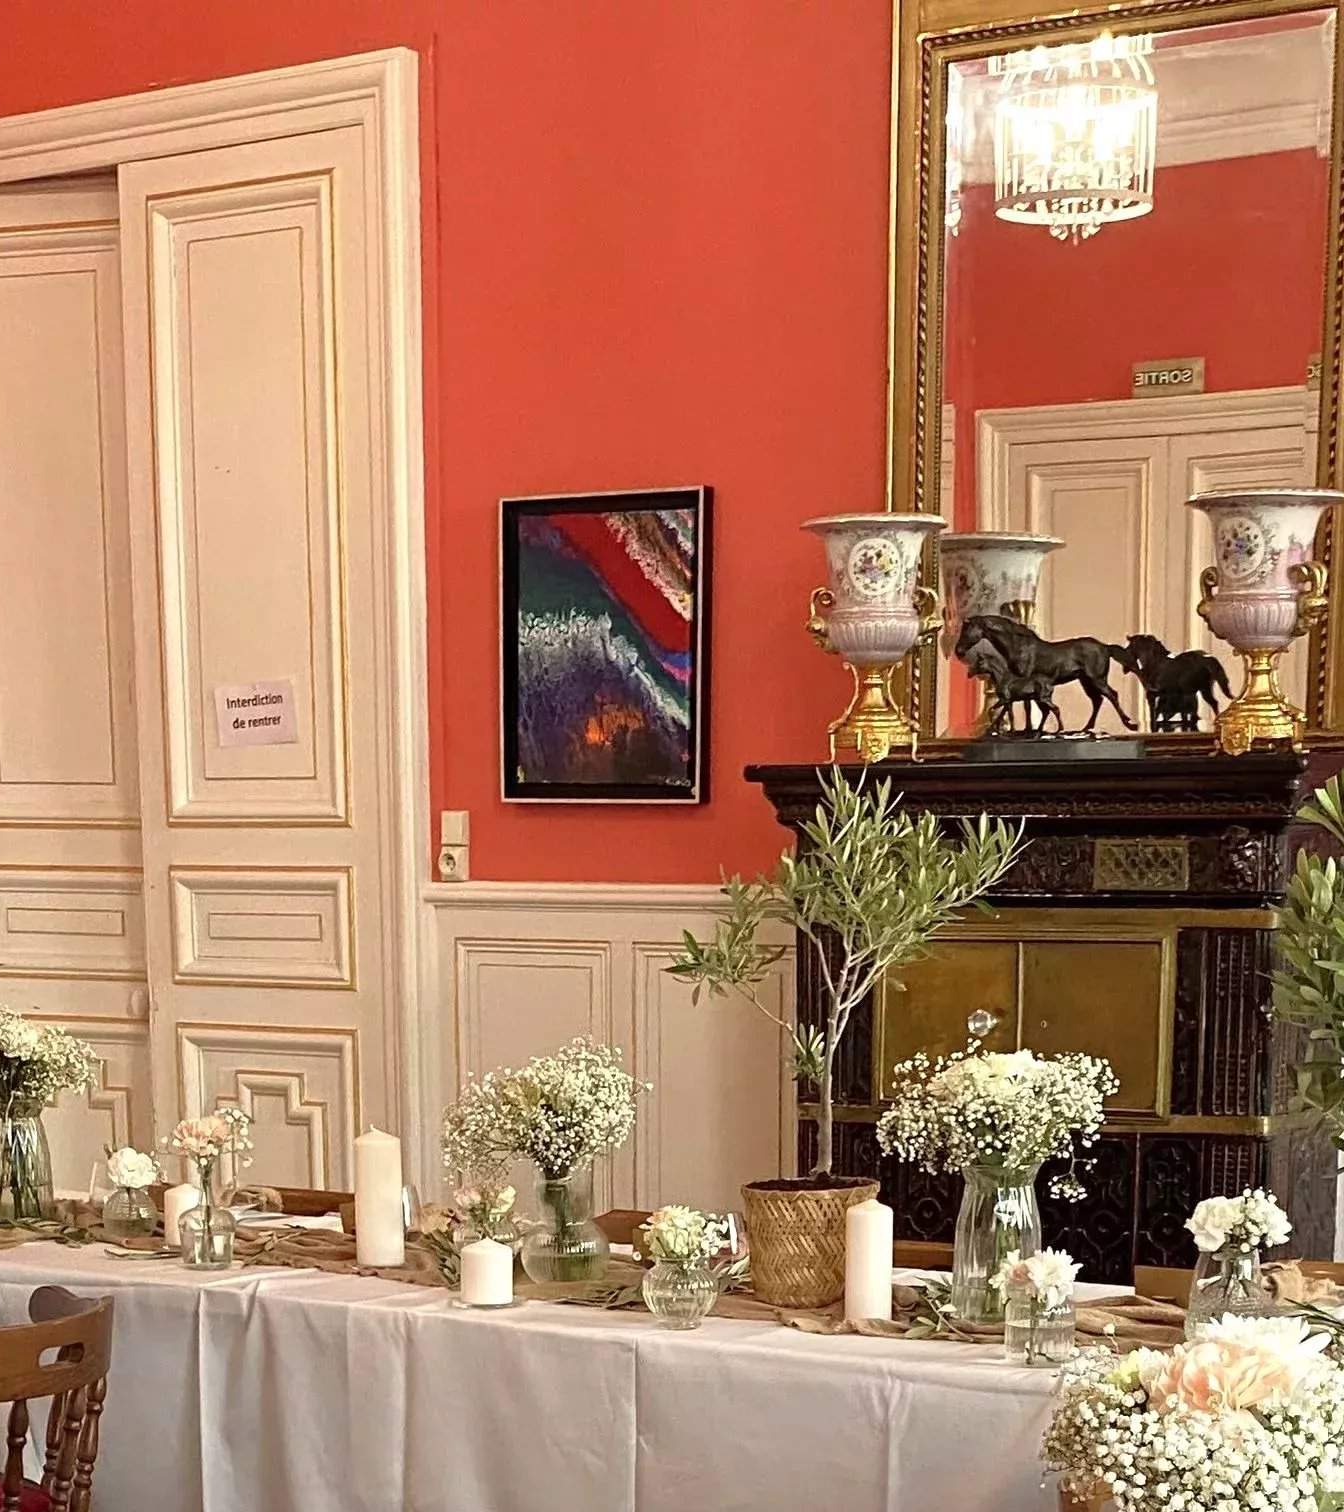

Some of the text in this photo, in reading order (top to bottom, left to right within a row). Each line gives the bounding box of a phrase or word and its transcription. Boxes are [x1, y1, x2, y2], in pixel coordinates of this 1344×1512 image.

[226, 693, 283, 710] Interdiction
[232, 715, 281, 729] de rentrer
